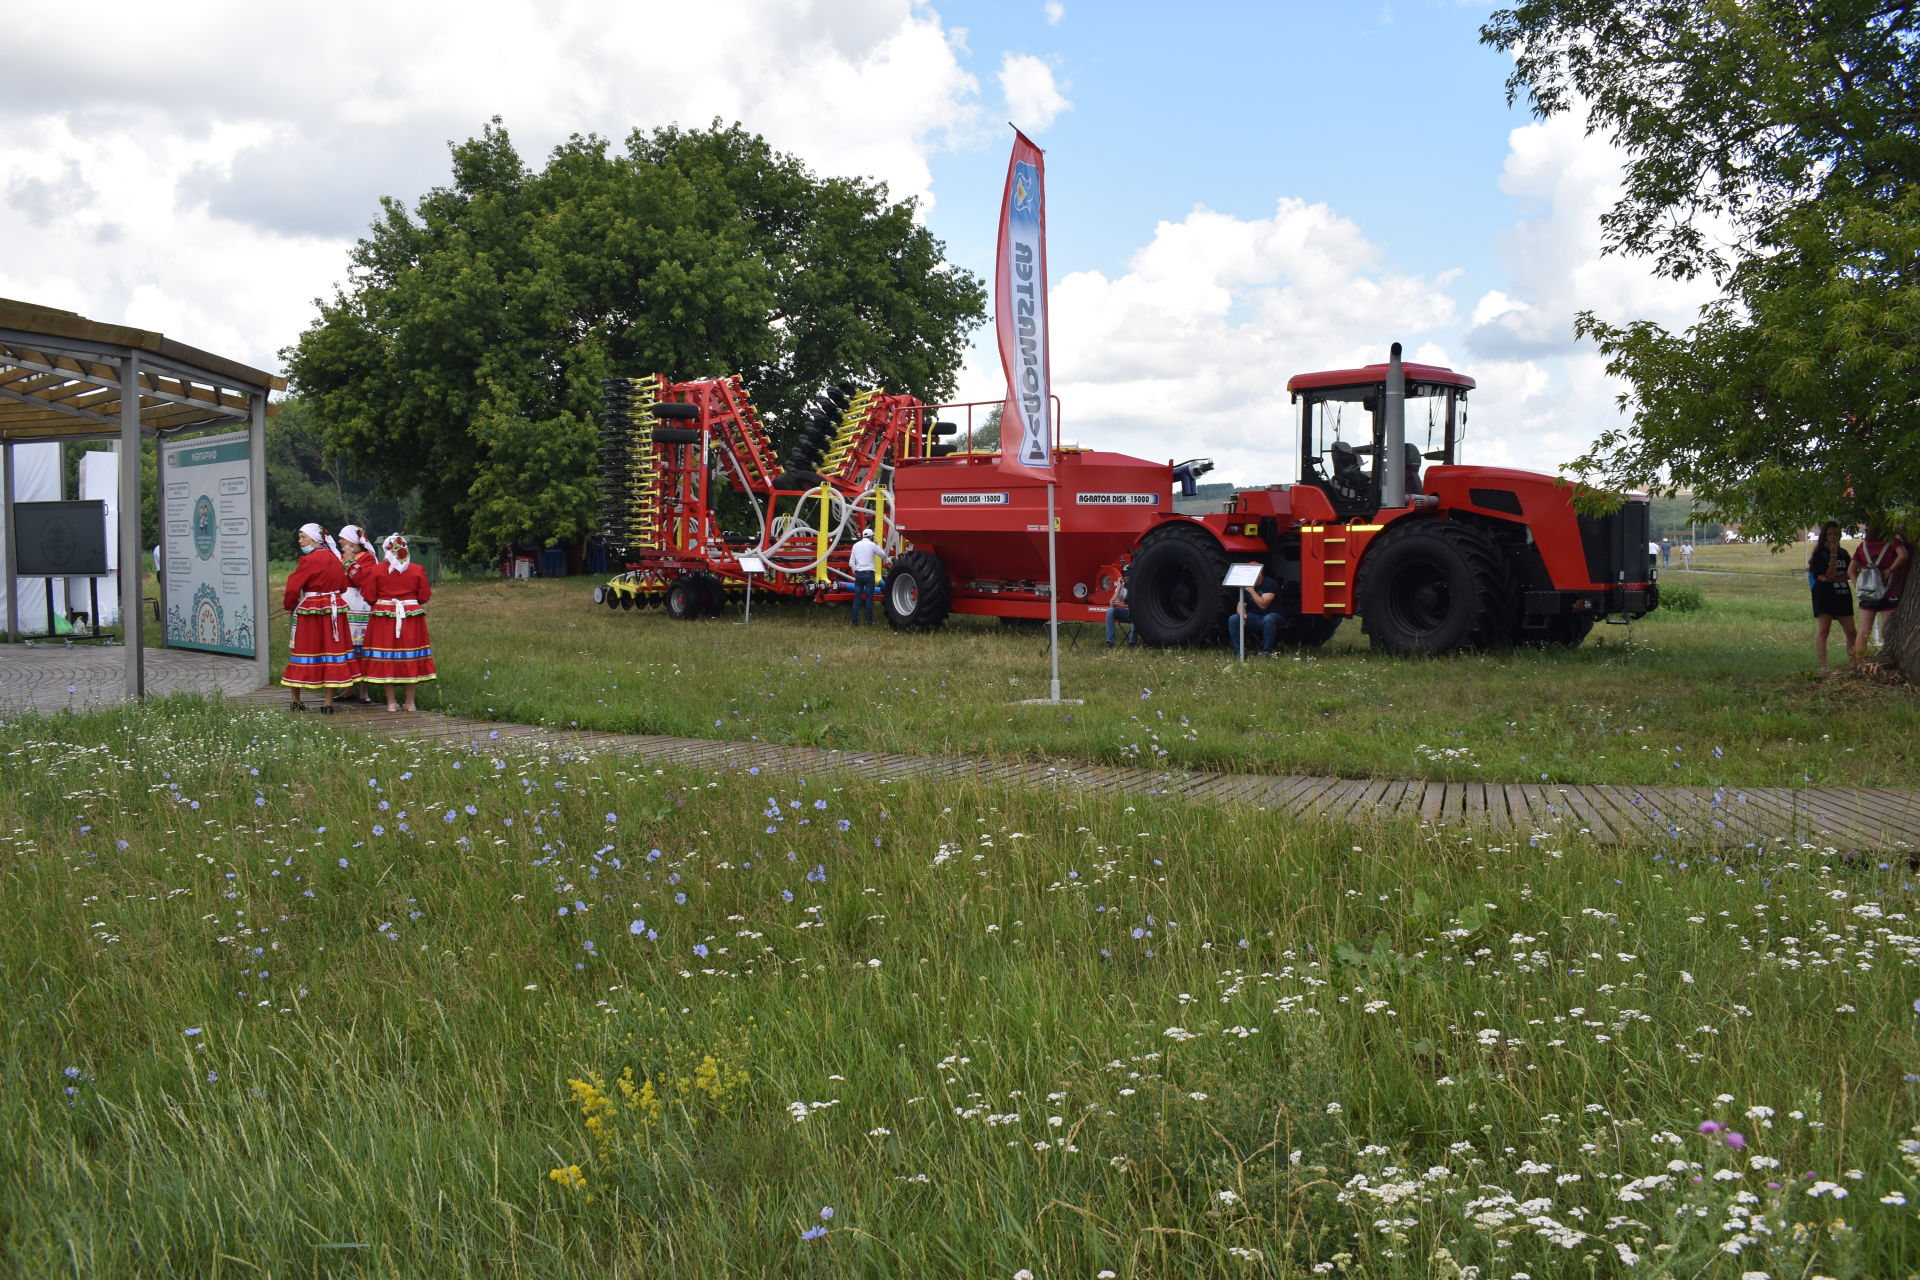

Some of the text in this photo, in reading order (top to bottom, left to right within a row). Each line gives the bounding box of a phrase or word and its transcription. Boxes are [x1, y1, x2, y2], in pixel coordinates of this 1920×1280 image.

[943, 495, 967, 503] AGRATOR
[969, 495, 980, 503] DISK
[1079, 495, 1110, 503] AGRATOR
[1112, 495, 1126, 503] DISK
